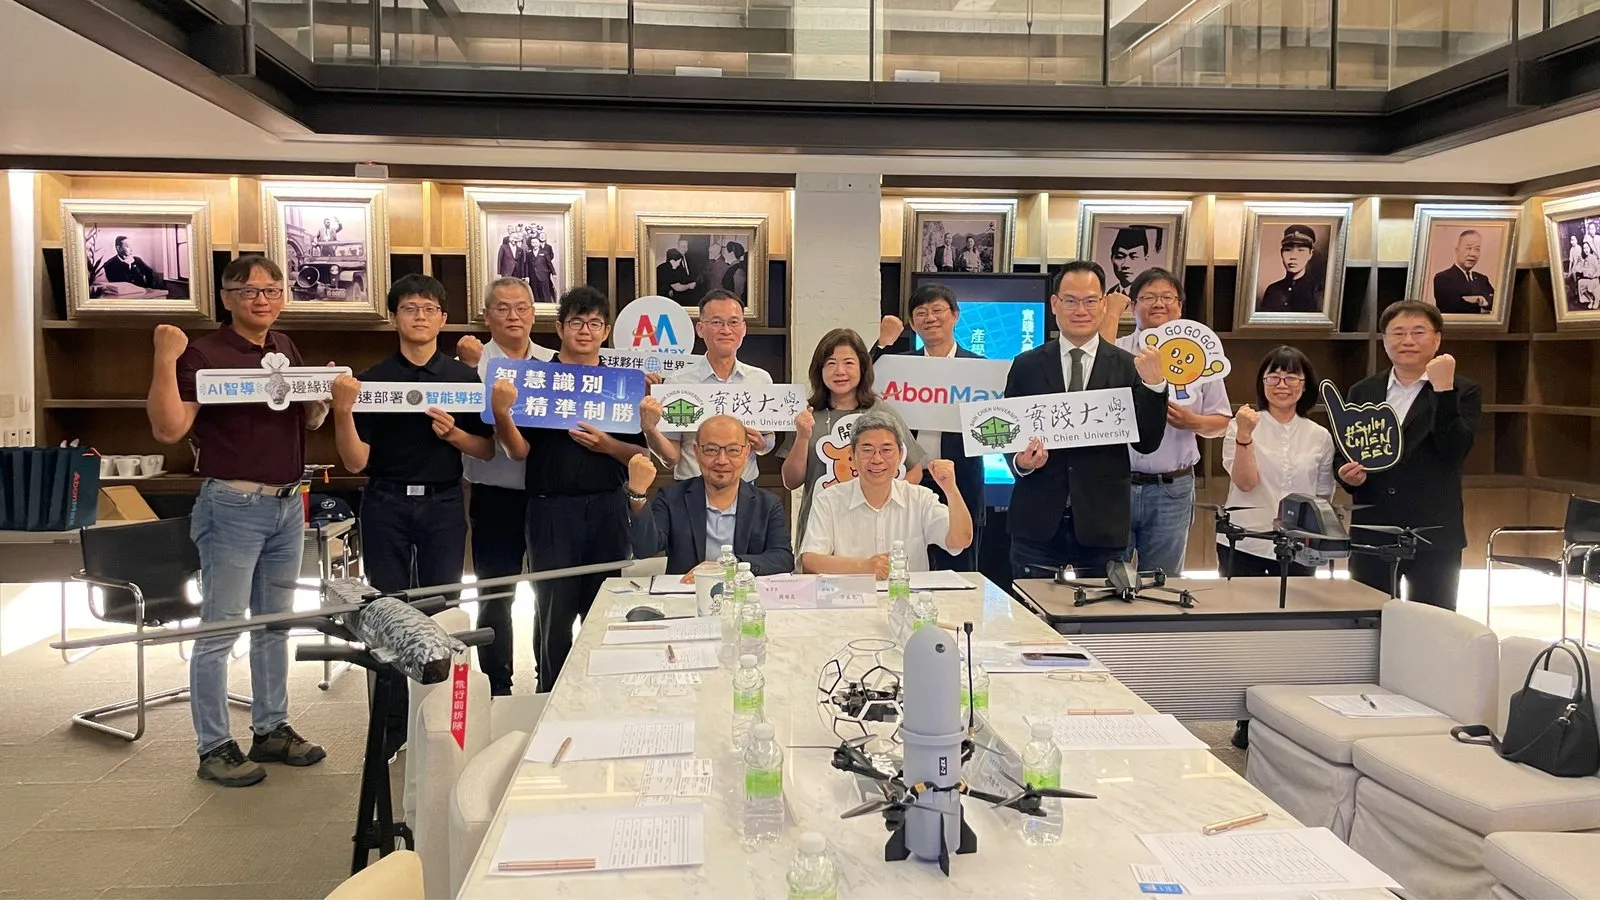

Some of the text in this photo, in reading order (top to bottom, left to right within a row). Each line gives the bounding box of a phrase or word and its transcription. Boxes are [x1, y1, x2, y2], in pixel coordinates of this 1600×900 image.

[1164, 325, 1220, 355] GO GO GO!
[663, 359, 694, 371] 世界一
[207, 380, 334, 396] AI智導 邊緣運
[494, 367, 603, 394] 智慧識別
[353, 391, 483, 404] 速部署 智能導控
[524, 396, 634, 422] 精準制勝
[709, 389, 800, 416] 實踐大學
[742, 418, 797, 426] ien Universit
[993, 406, 1020, 422] UNIVERSITY
[1024, 396, 1127, 433] 實踐大學
[1028, 429, 1130, 445] Sih Chien University
[1345, 426, 1393, 449] CHIEN
[452, 680, 466, 731] 飛行前拆除
